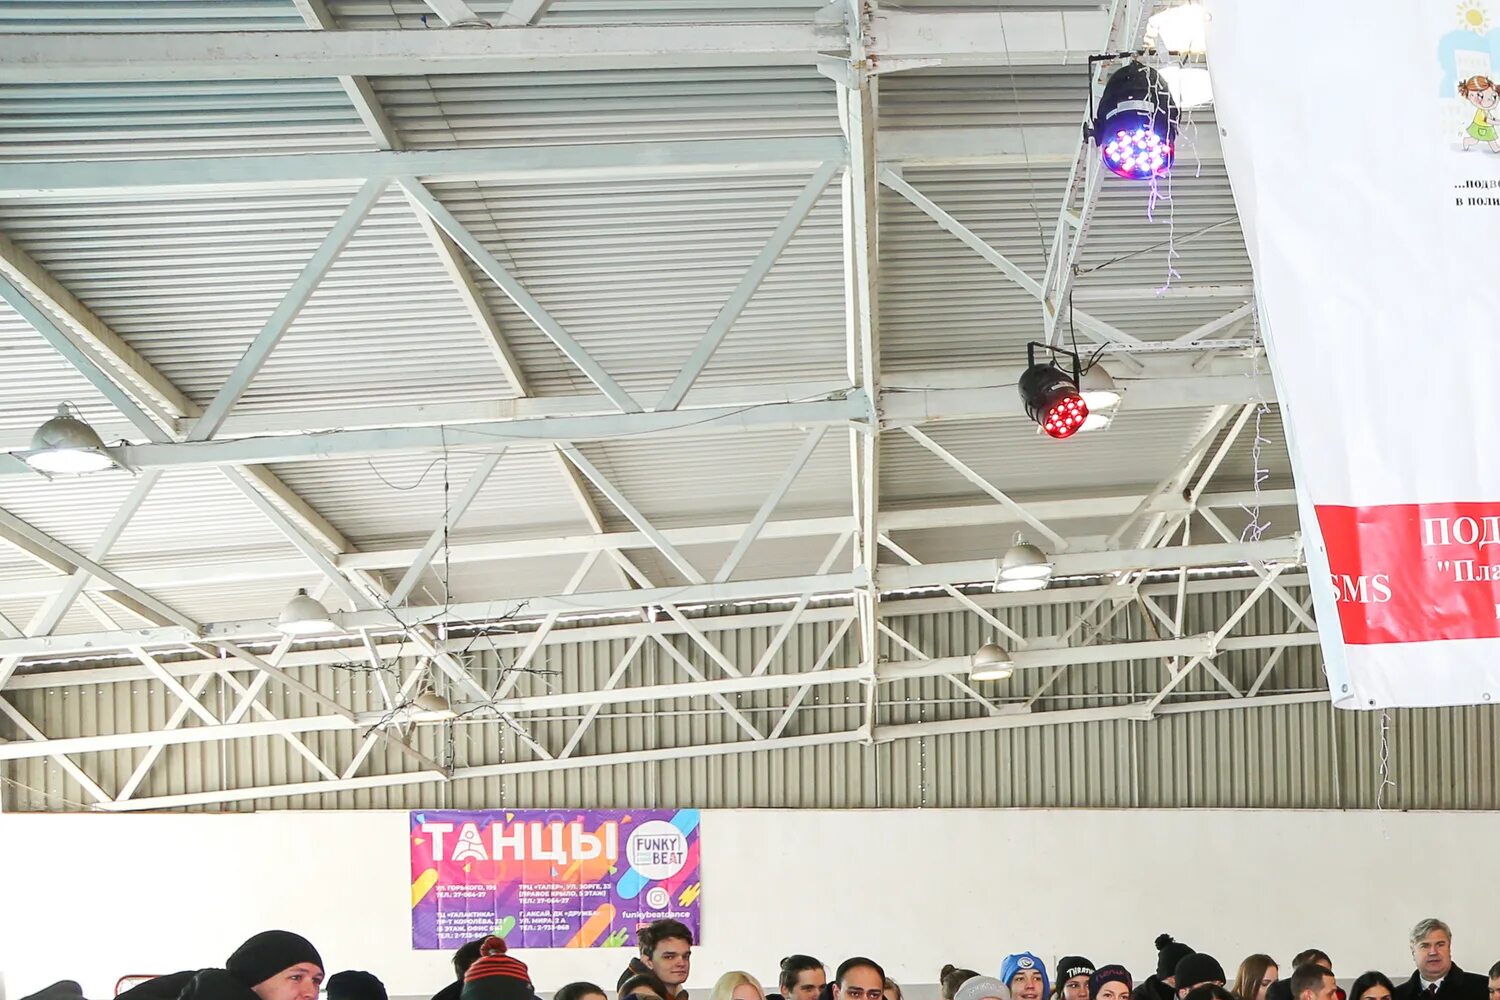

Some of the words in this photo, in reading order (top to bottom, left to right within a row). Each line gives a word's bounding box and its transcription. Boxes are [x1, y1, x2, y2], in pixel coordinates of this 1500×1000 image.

[1455, 196, 1464, 206] в
[1329, 572, 1393, 604] SMS
[421, 821, 618, 865] ТАНЦЫ
[636, 838, 678, 852] FUNKY
[652, 851, 684, 866] BEAT
[621, 910, 691, 921] funkybeatdance
